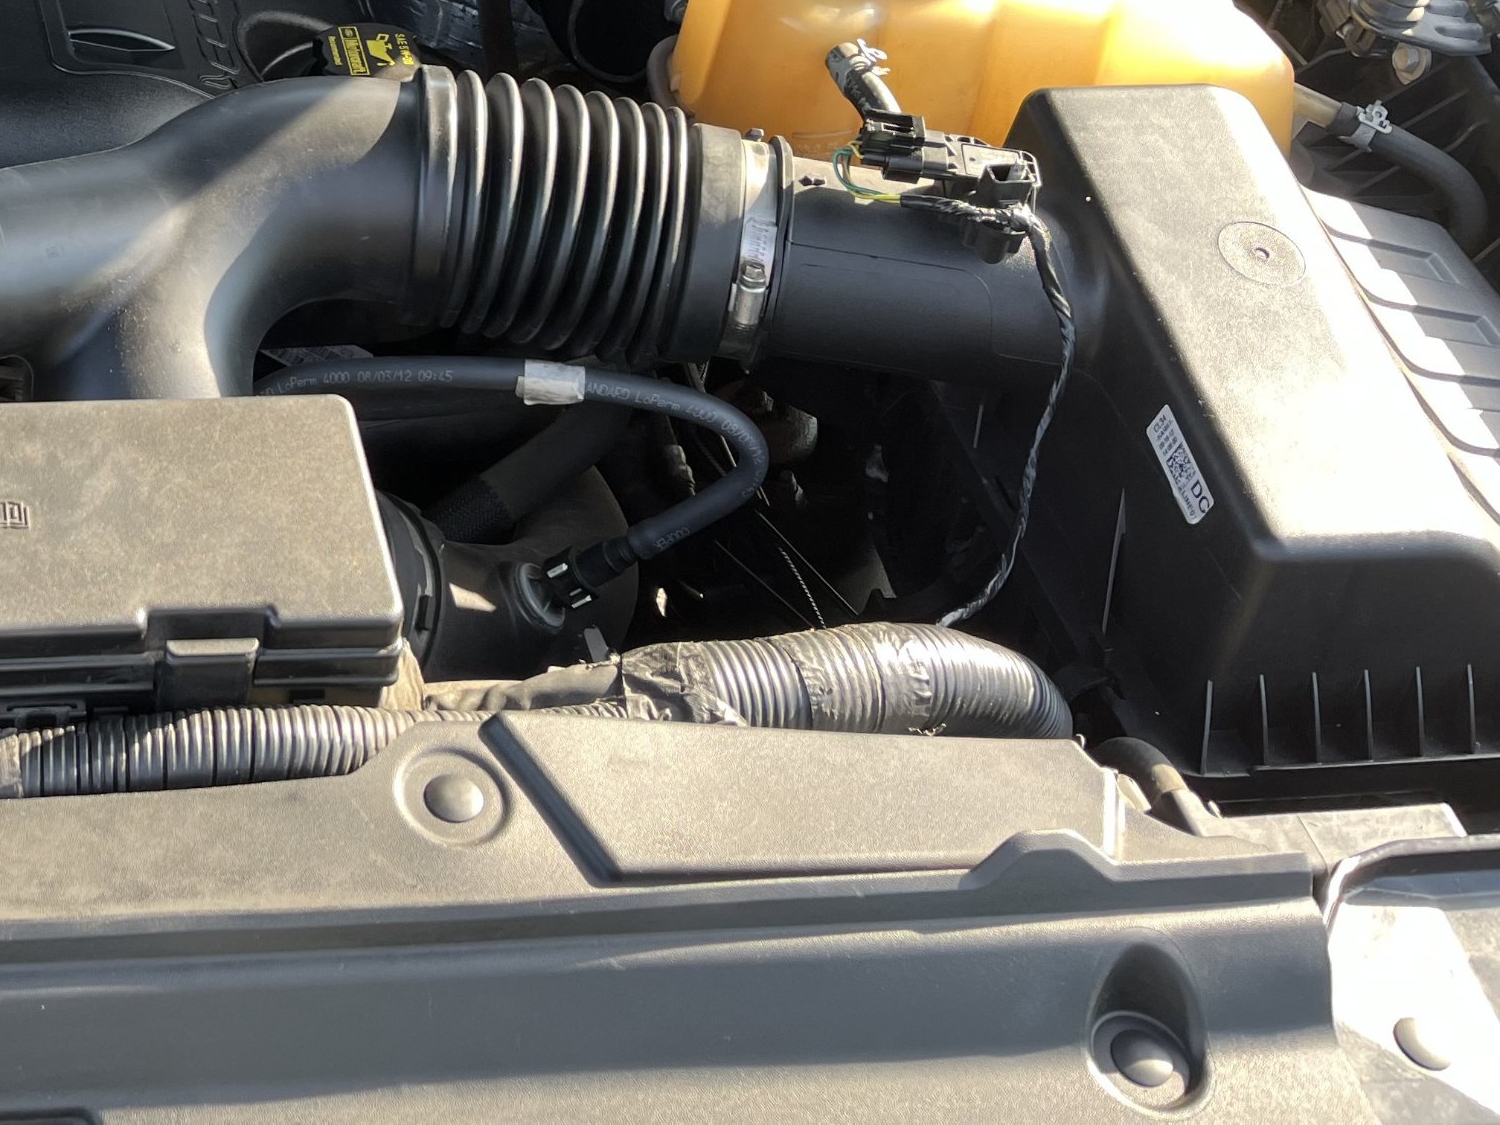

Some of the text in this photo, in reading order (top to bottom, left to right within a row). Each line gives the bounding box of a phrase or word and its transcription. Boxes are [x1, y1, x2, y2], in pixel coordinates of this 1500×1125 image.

[277, 377, 317, 394] LoPerm
[323, 371, 350, 384] 4000
[418, 370, 453, 383] 09:45
[585, 381, 630, 400] ANDARD
[635, 393, 680, 412] LoPerm
[1190, 479, 1211, 514] DC
